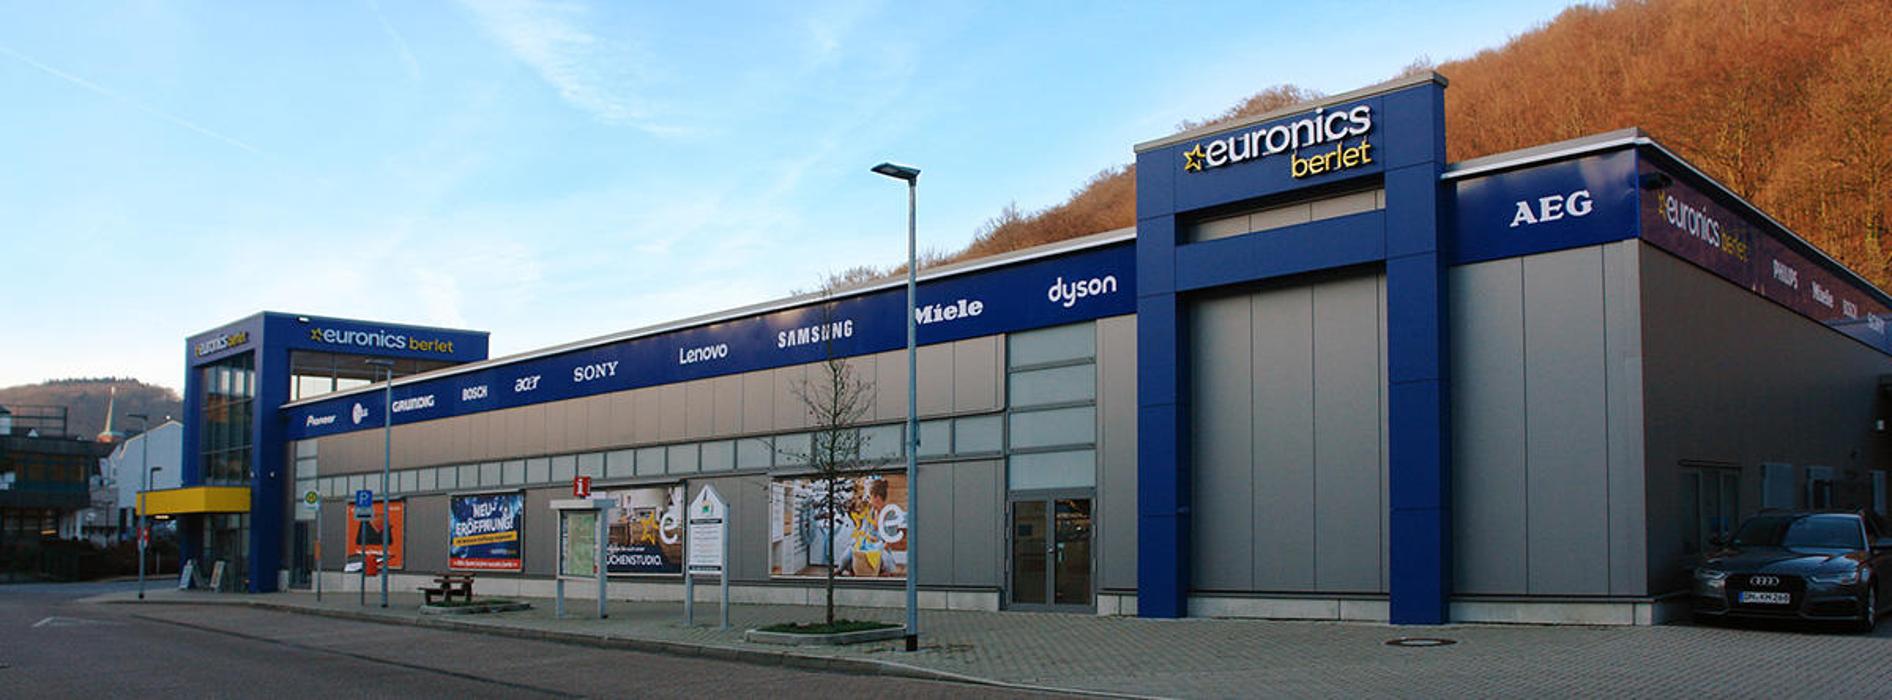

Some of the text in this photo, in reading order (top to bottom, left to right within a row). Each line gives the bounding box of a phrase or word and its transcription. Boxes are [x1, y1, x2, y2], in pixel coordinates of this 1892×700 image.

[1205, 105, 1372, 167] euronics
[1290, 140, 1372, 178] berlet
[1510, 189, 1594, 229] AEG
[1666, 195, 1721, 248] euronics
[1047, 275, 1118, 308] dyson
[914, 298, 984, 327] Miele
[323, 328, 456, 354] euronics berlet
[777, 319, 854, 348] SAMSUNG
[679, 343, 728, 365] Lenovo
[514, 375, 541, 392] acer
[573, 361, 619, 383] SONY
[392, 395, 435, 413] GRUNDIG
[462, 385, 488, 402] BOSCH
[472, 501, 498, 518] NEU-
[455, 512, 514, 537] ERÖFFNUNG!
